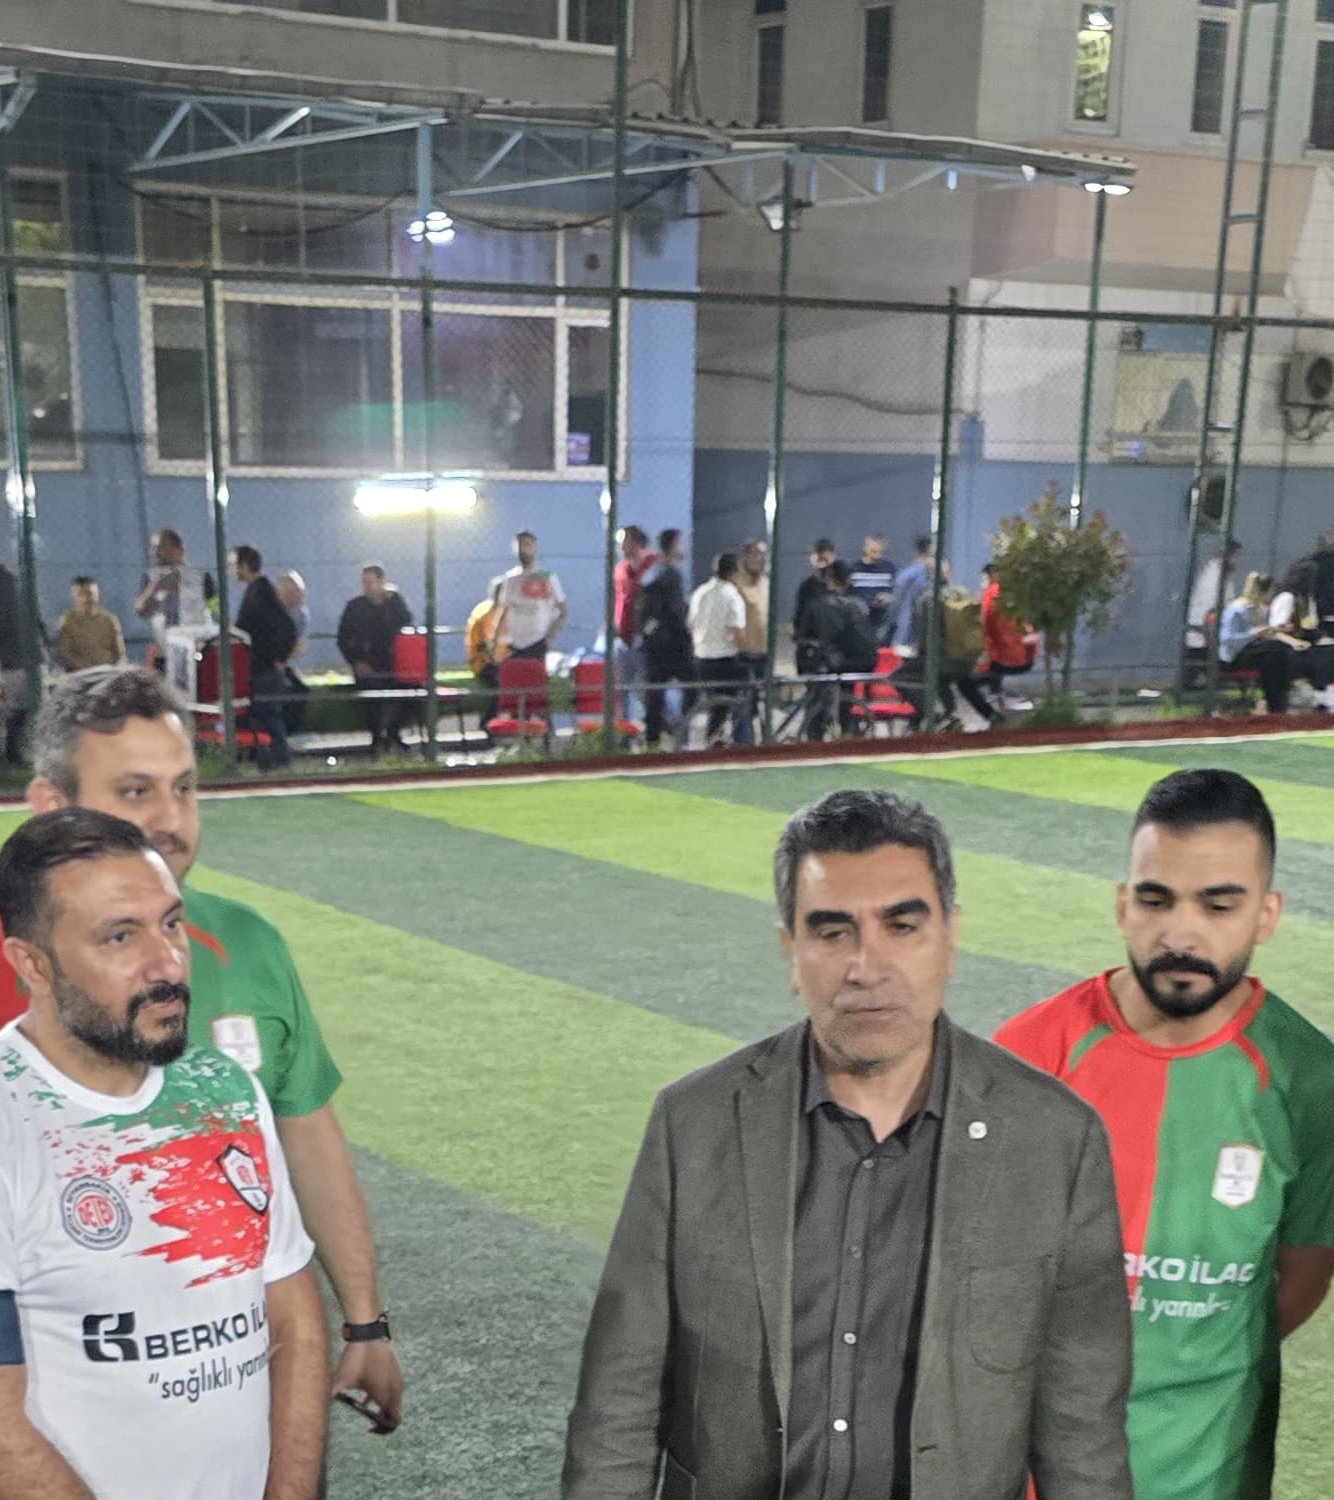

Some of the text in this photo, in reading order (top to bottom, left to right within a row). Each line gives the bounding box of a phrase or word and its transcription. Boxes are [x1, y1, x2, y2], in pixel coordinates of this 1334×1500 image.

[1123, 1252, 1186, 1282] RKO
[145, 1301, 267, 1360] BERKO İL
